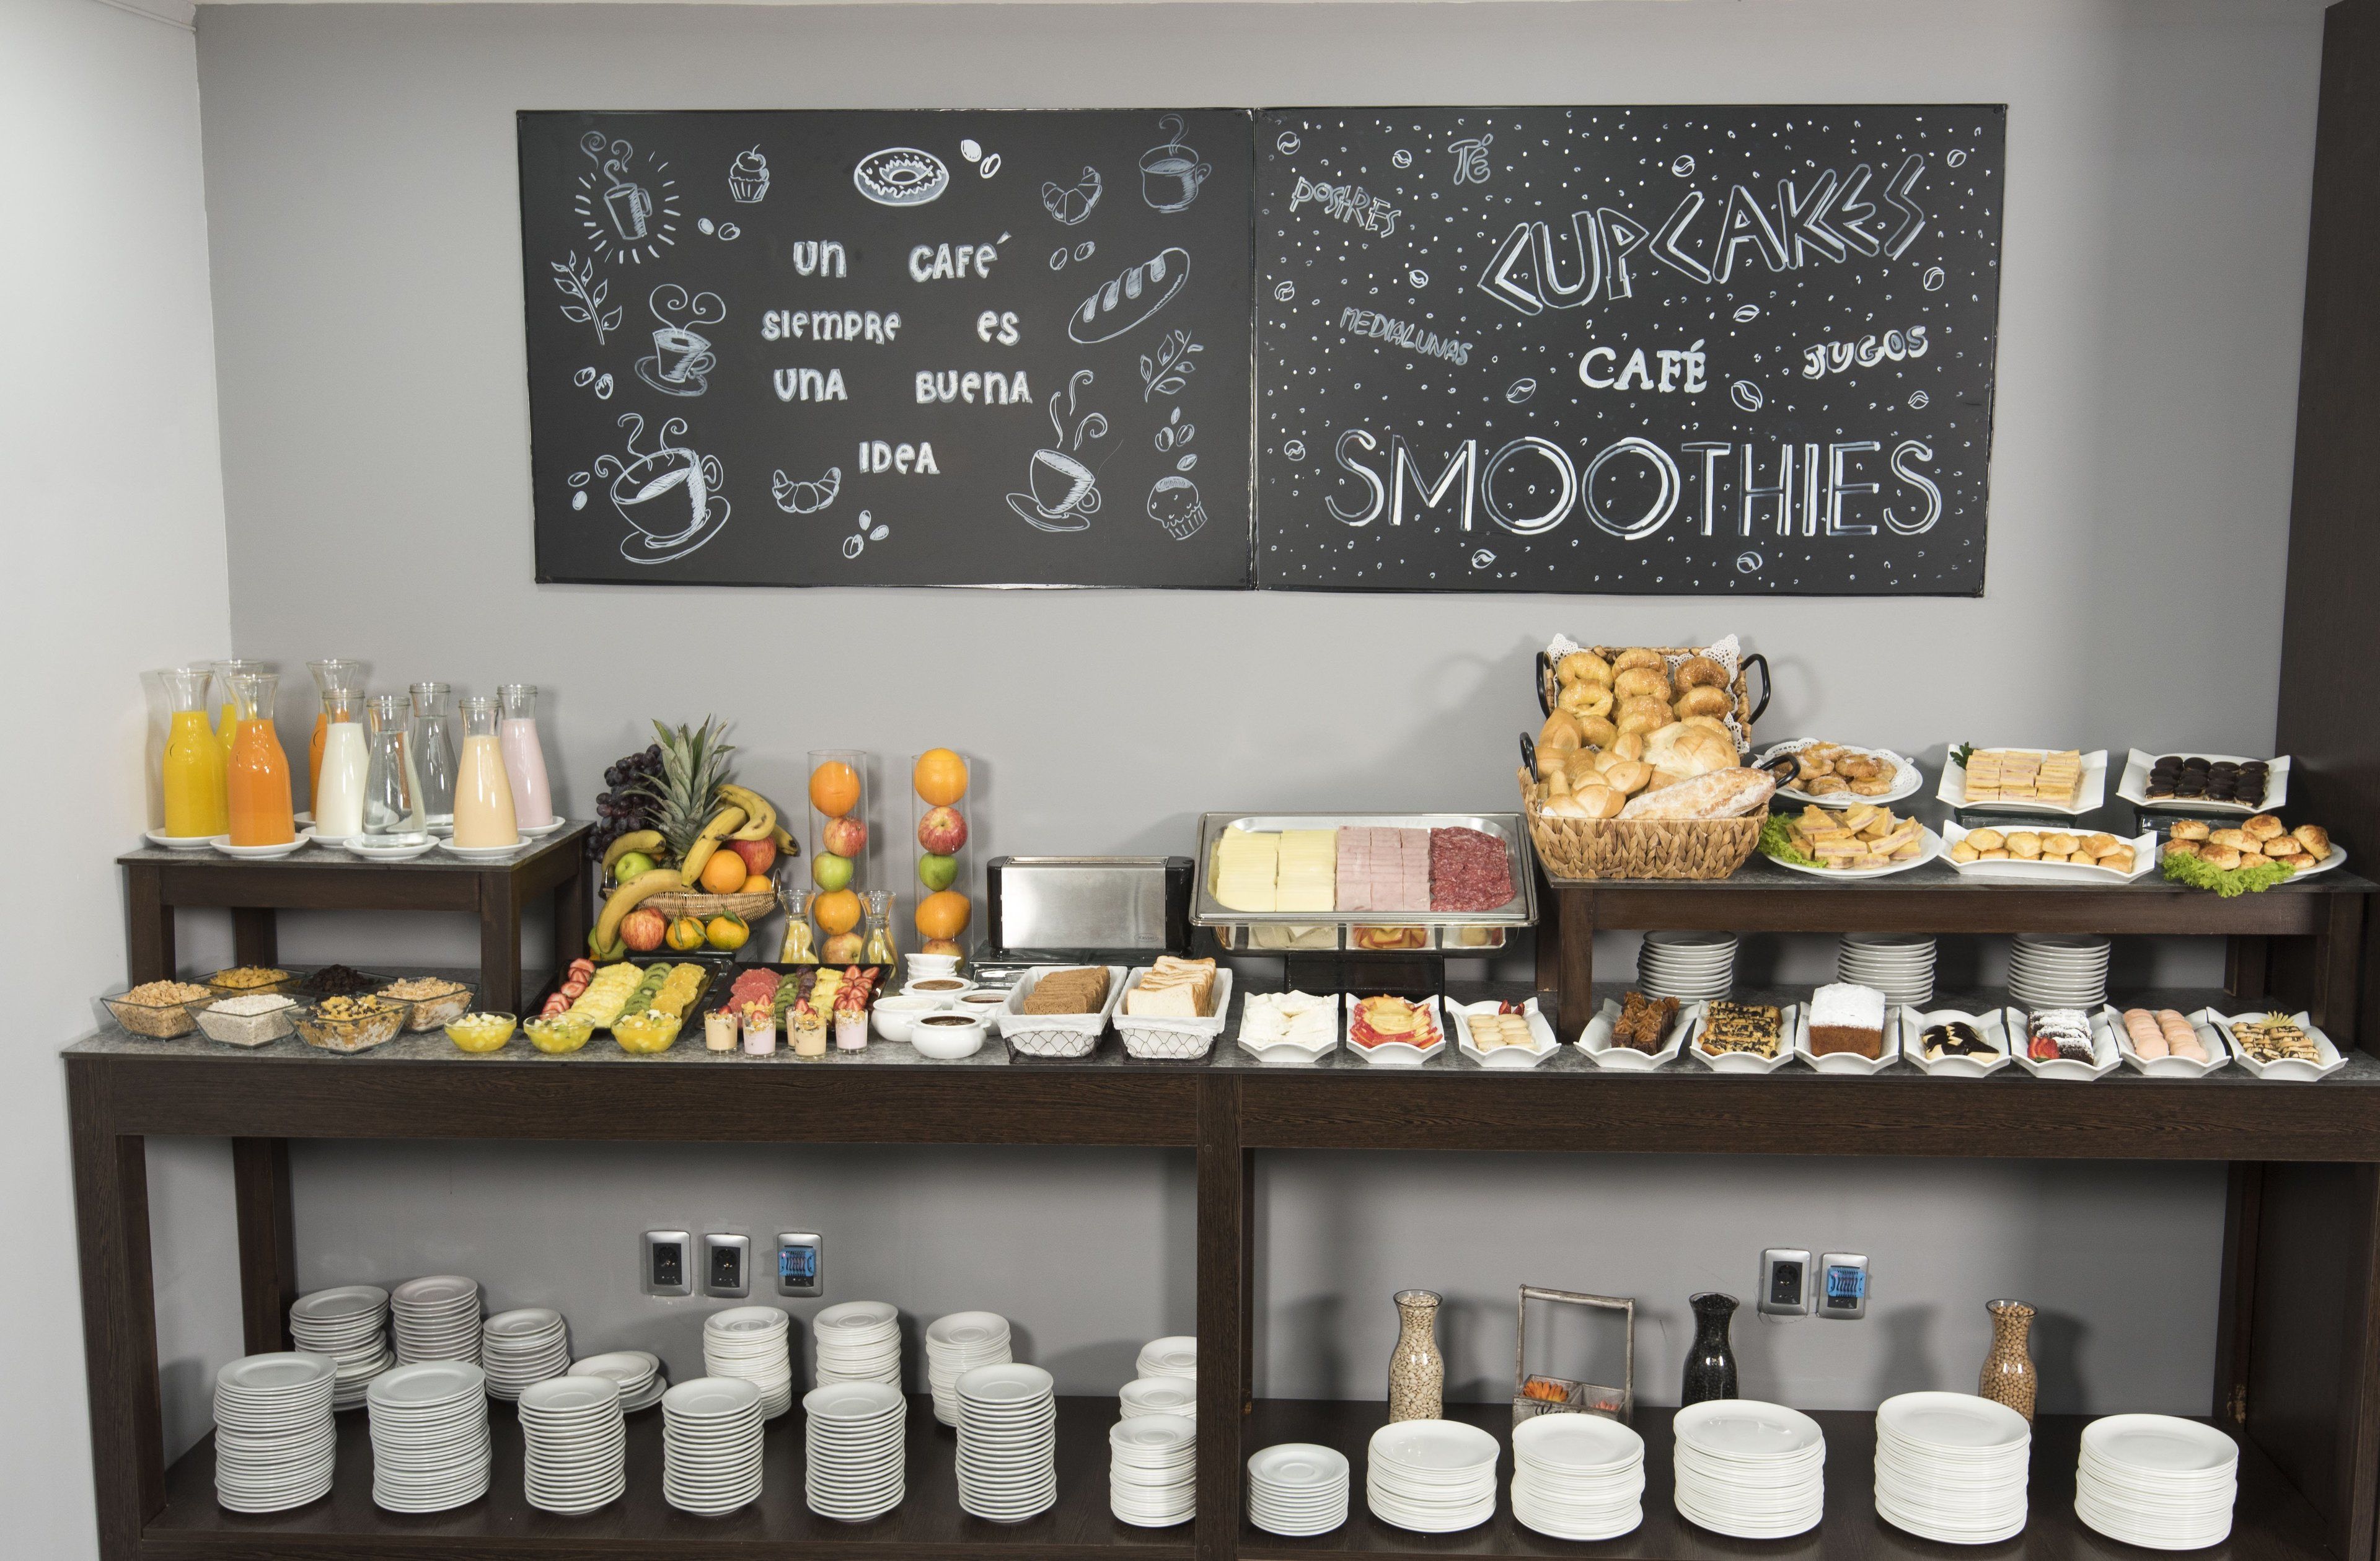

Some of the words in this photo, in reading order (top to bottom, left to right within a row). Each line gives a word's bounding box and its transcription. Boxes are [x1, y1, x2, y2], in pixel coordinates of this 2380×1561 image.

[1476, 153, 1926, 316] CUPCAKES
[1339, 306, 1473, 366] MEDIALUNAS
[1801, 325, 1929, 380] JUGOS
[1579, 339, 1708, 394] CAFÉ
[1324, 429, 1942, 541] SMOOTHIES
